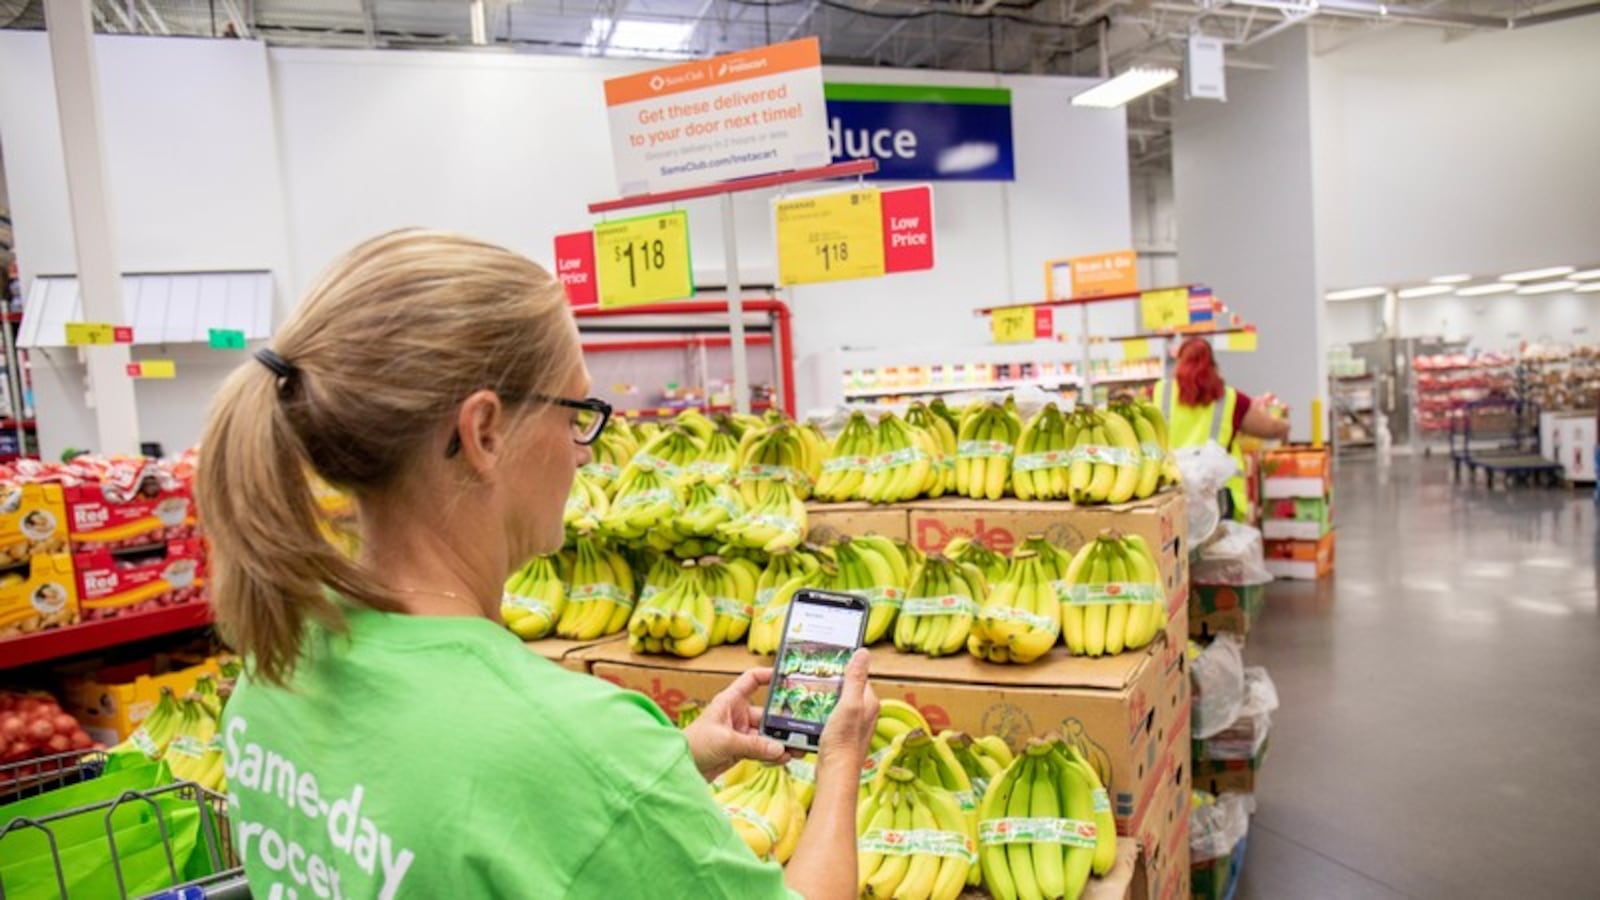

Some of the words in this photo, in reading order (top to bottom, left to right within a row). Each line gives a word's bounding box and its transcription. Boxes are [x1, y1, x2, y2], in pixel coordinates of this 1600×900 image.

[638, 109, 665, 125] Get
[668, 100, 709, 120] these
[713, 85, 788, 111] delivered
[630, 133, 645, 148] to
[649, 128, 681, 147] your
[685, 120, 719, 137] door
[724, 111, 758, 128] next
[762, 103, 804, 124] time!
[827, 117, 917, 158] duce
[890, 217, 919, 231] Low
[891, 232, 927, 247] Price
[559, 258, 582, 271] Low
[224, 716, 415, 900] Same-day
[228, 793, 346, 900] rocer
